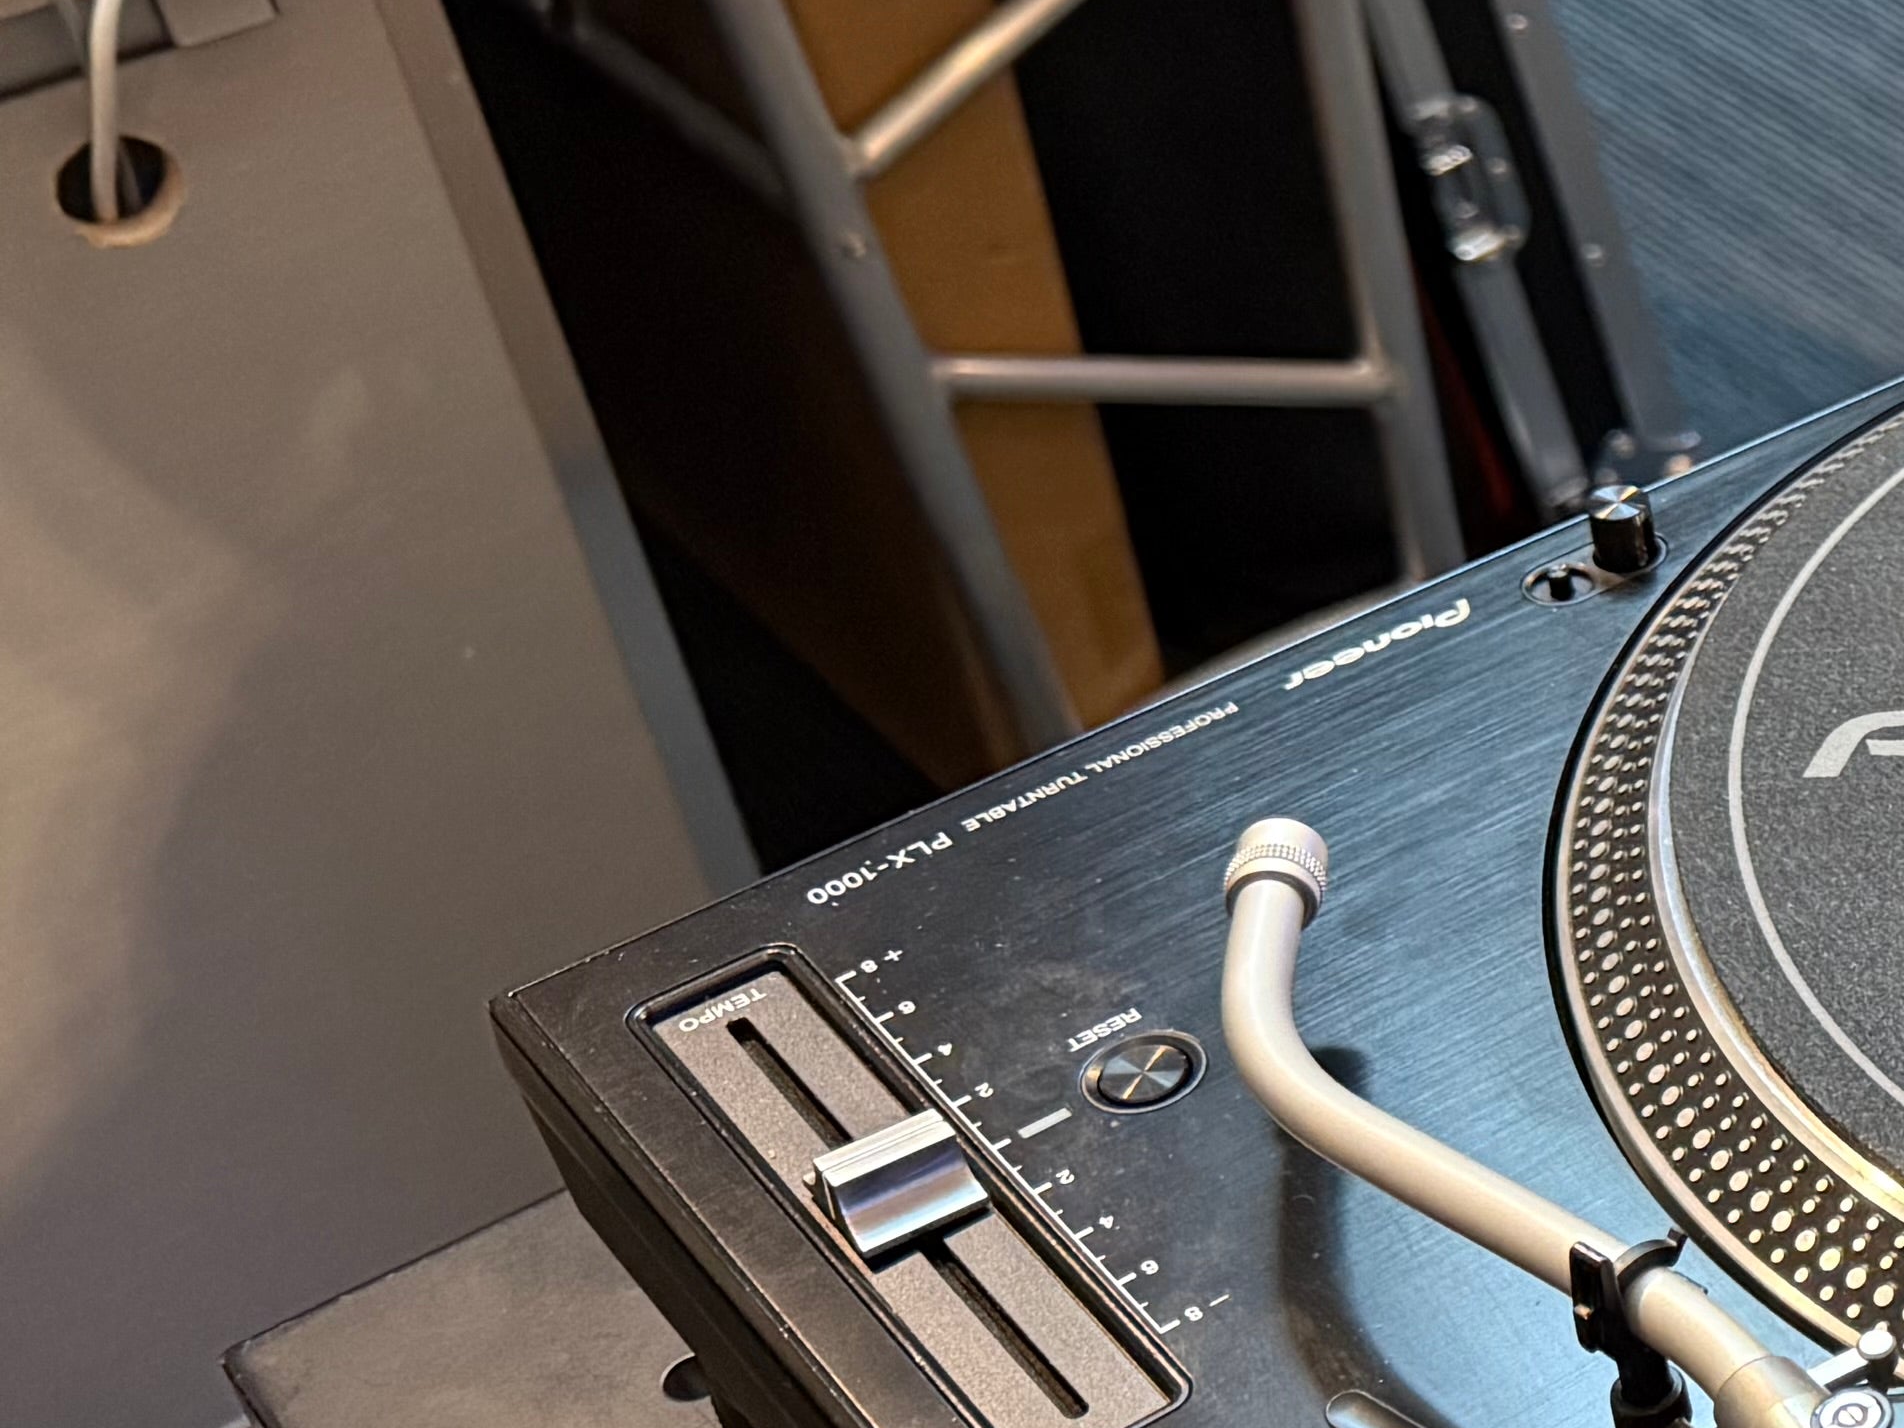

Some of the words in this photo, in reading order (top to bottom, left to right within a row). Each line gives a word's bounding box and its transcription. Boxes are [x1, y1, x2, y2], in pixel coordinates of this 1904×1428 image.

[1282, 598, 1471, 691] Pioneer
[1088, 701, 1240, 774] PROFESSIONAL
[961, 770, 1088, 832] TURNTABLE
[806, 831, 953, 906] PLX-1000
[678, 987, 768, 1033] TEMPO
[897, 1000, 917, 1017] 6
[1067, 1007, 1143, 1053] RESET
[937, 1042, 953, 1057] 4
[976, 1083, 994, 1099] 2
[1056, 1169, 1076, 1186] 2
[1099, 1215, 1114, 1229] 4
[1140, 1259, 1160, 1276] 6
